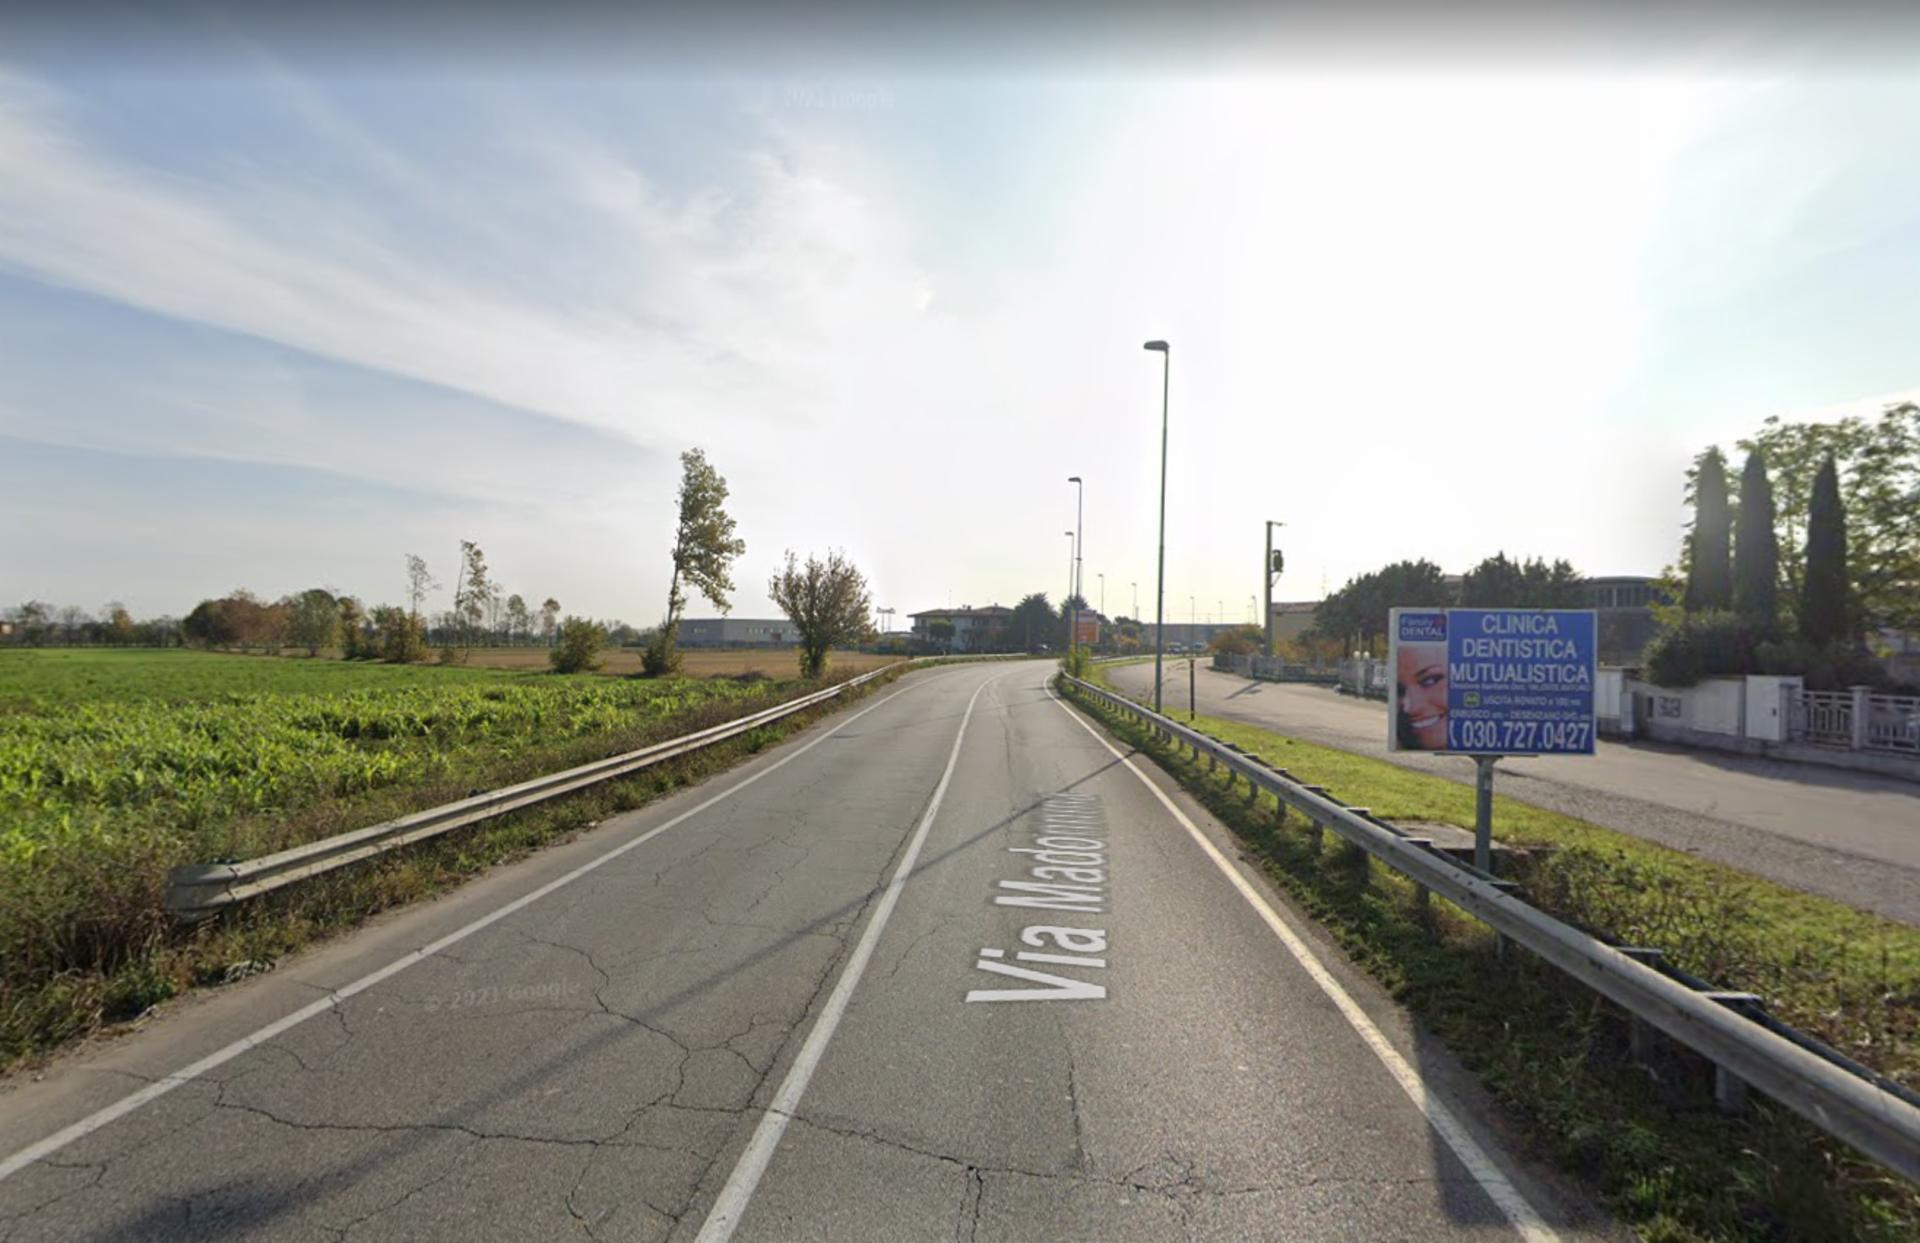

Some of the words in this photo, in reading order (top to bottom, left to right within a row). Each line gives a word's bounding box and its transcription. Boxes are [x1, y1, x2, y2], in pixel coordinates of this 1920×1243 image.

[1401, 626, 1444, 637] DENTAL
[1482, 614, 1558, 634] CLINICA
[1462, 639, 1577, 659] DENTISTICA
[1450, 663, 1589, 683] MUTUALISTICA
[1462, 720, 1590, 749] 030.727.0427
